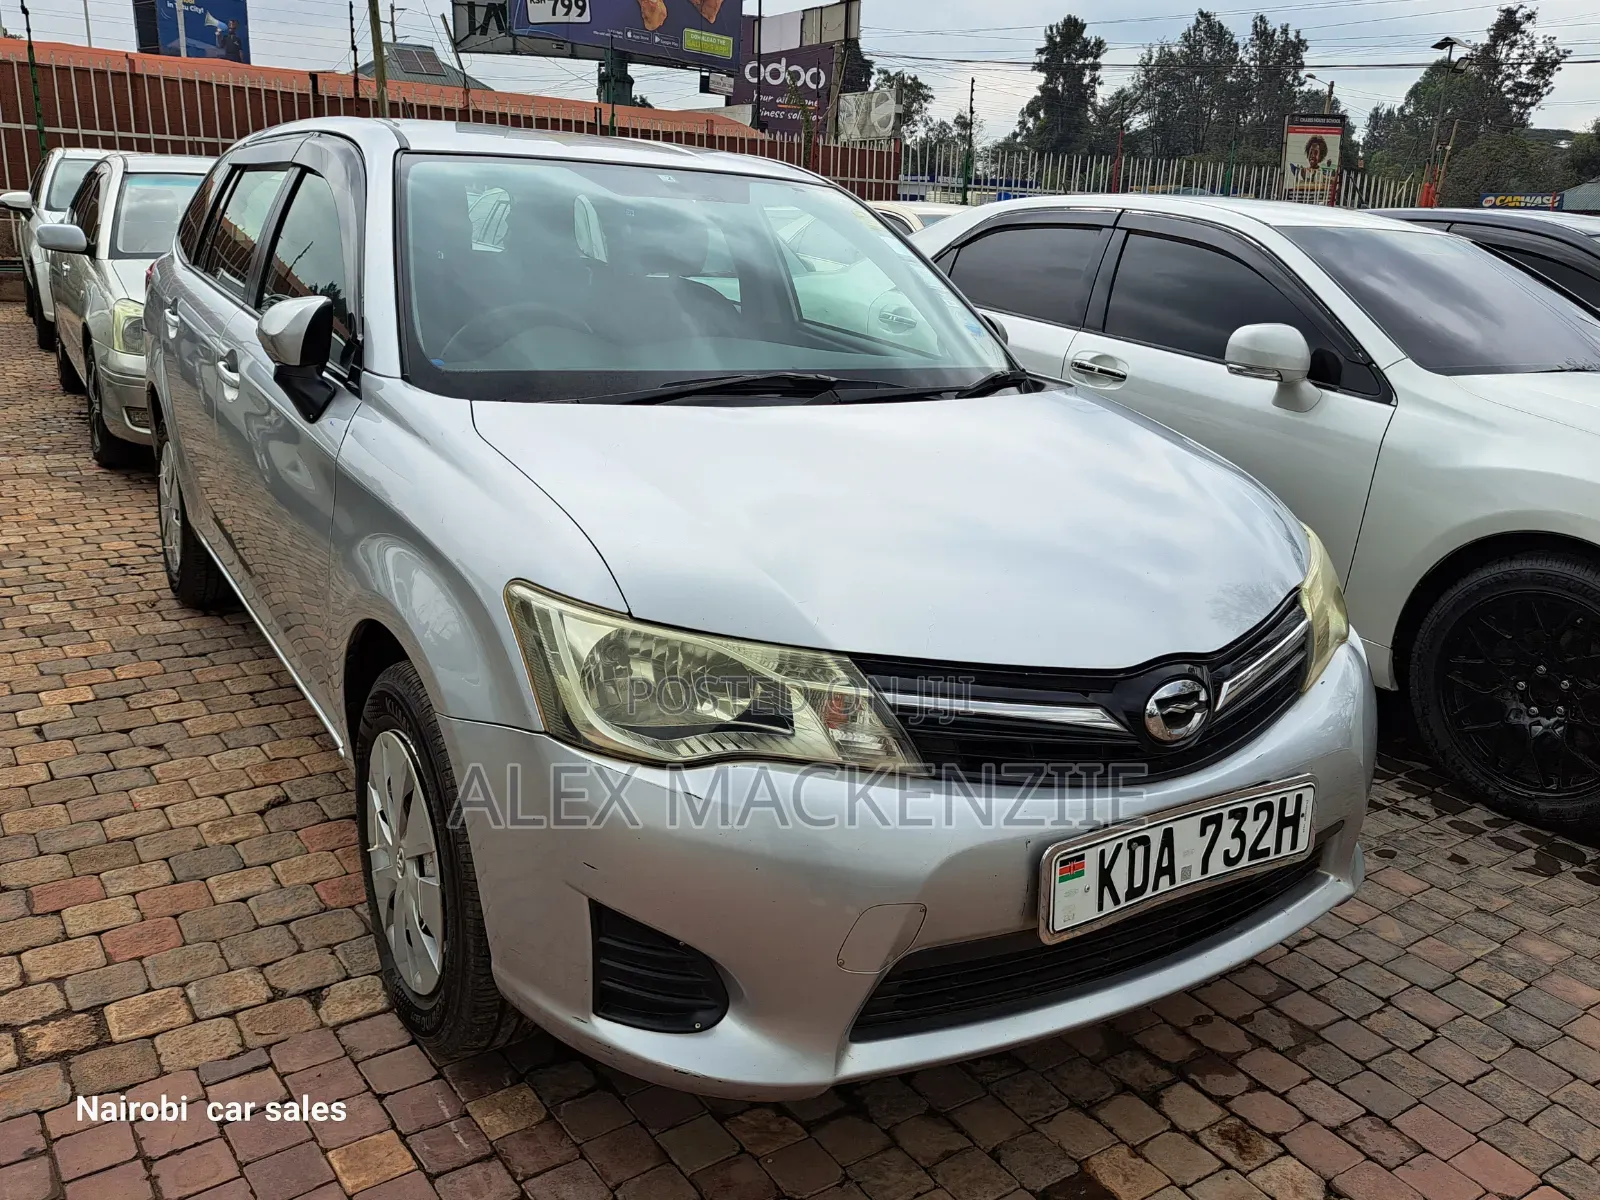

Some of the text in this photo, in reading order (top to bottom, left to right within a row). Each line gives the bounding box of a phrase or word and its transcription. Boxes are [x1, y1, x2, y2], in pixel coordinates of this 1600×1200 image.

[548, 0, 587, 17] 799
[744, 57, 826, 90] odoo
[1097, 826, 1177, 912] KDA
[1199, 793, 1303, 876] 732H
